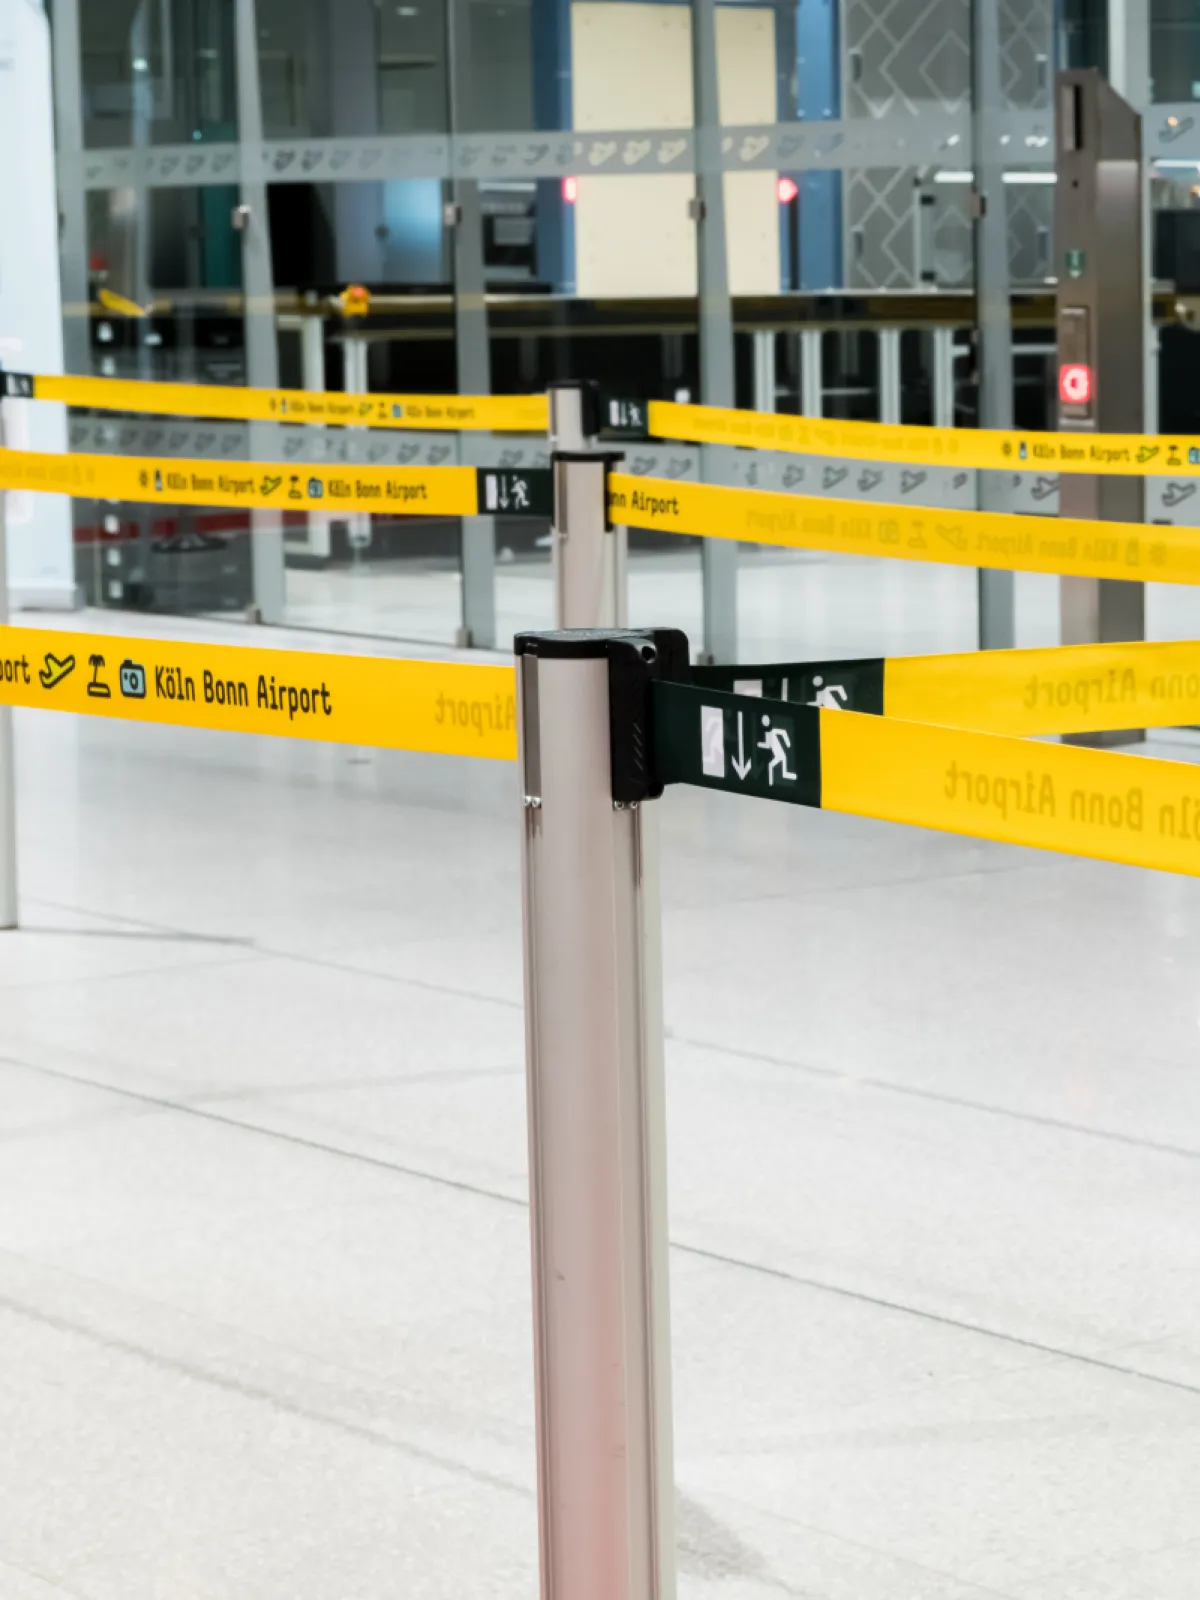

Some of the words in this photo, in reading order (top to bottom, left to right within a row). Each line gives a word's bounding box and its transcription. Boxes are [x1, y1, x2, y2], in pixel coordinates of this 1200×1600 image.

[327, 479, 351, 498] Köln
[355, 479, 382, 499] Bonn
[385, 480, 428, 503] Airport
[632, 490, 679, 516] Airport
[156, 666, 195, 701] Köln
[204, 670, 248, 706] Bonn
[258, 675, 332, 720] Airport
